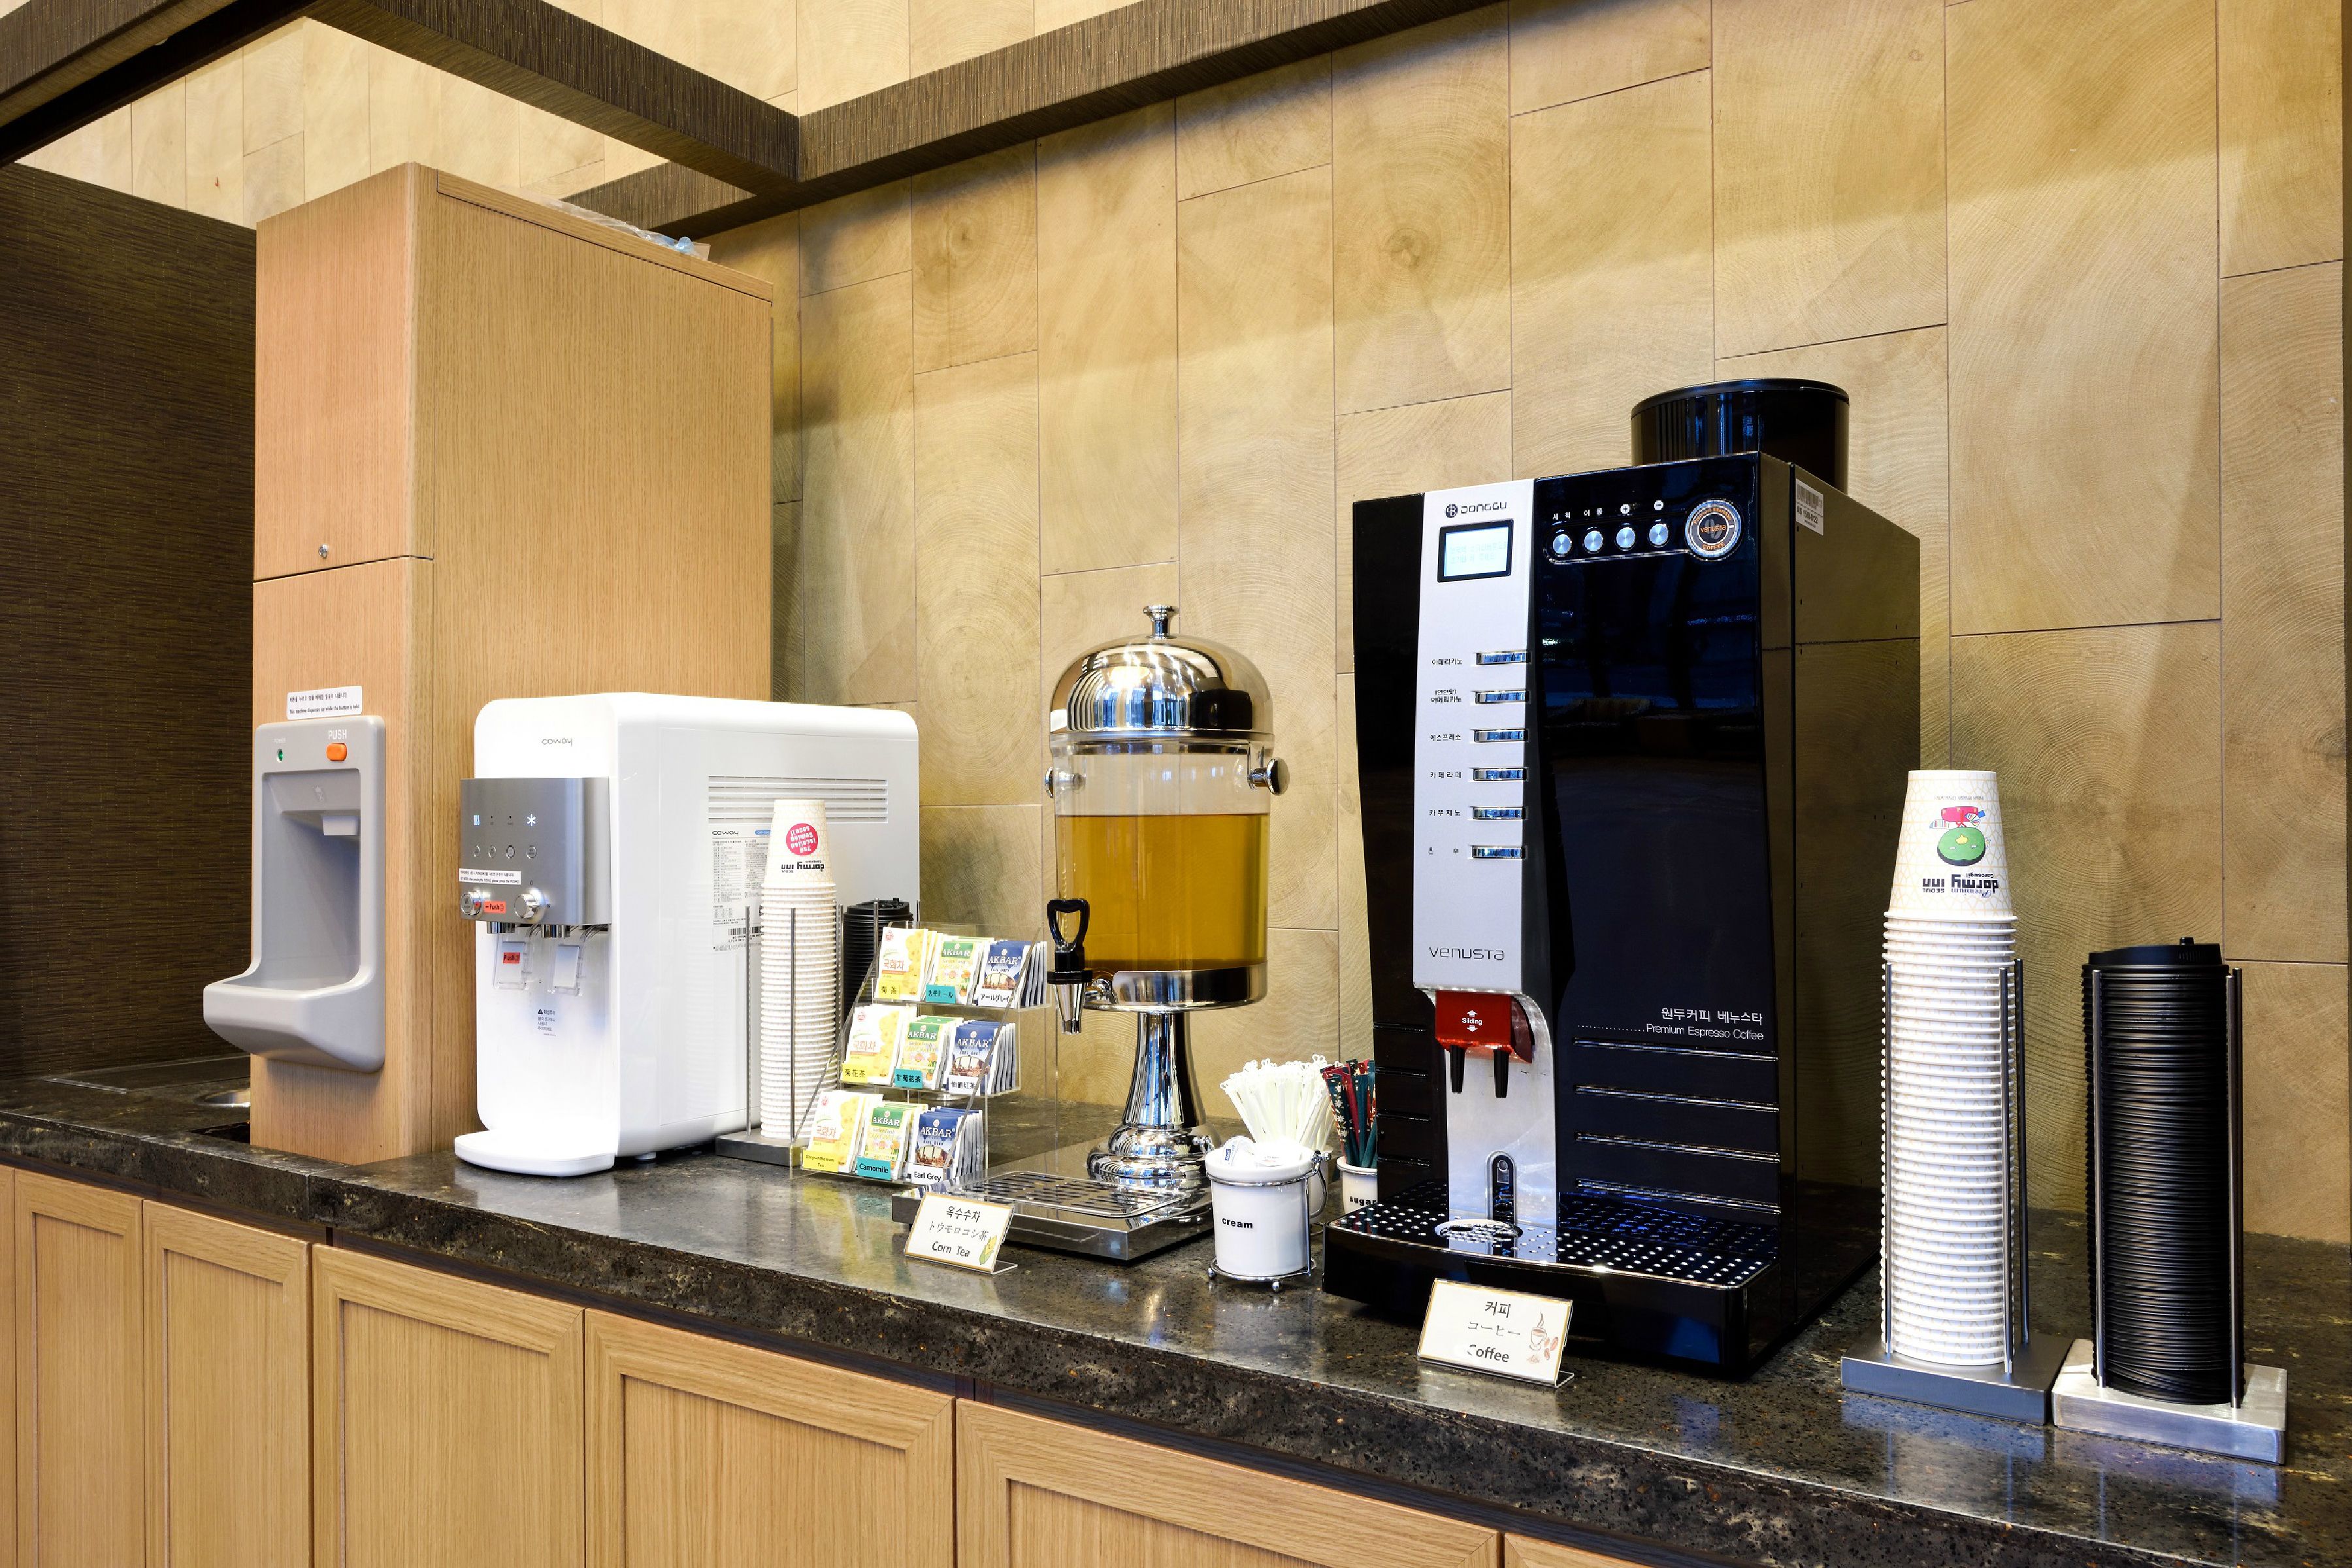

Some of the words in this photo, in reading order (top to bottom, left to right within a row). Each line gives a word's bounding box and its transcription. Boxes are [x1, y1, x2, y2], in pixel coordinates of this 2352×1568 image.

[328, 729, 348, 740] PUSH
[542, 738, 573, 747] coway
[797, 862, 825, 872] dormy
[1923, 878, 1945, 887] inn
[1951, 874, 1999, 892] dormy
[1952, 887, 1991, 898] Premium
[988, 956, 1018, 965] AKBAR
[928, 990, 953, 998] カモミール
[1462, 1017, 1482, 1026] Sliding
[1661, 1007, 1711, 1022] 원두커피
[1717, 1011, 1763, 1026] 베누스타
[908, 1031, 936, 1039] AKBAR
[1646, 1023, 1685, 1035] Premium
[1688, 1025, 1730, 1038] Espresso
[1733, 1029, 1764, 1040] Coffee
[956, 1038, 988, 1047] AKBAR
[872, 1117, 900, 1126] AKBAR
[920, 1126, 952, 1137] AKBAR
[859, 1163, 889, 1173] Camomile
[926, 1173, 941, 1182] Grey
[1349, 1196, 1377, 1206] sugar
[947, 1206, 981, 1223] 옥수수차
[1222, 1217, 1253, 1229] cream
[930, 1221, 989, 1241] トウモロコシ茶
[932, 1241, 951, 1254] Corn
[956, 1245, 970, 1257] Tea
[1485, 1301, 1511, 1318] 커피
[1467, 1322, 1520, 1336] コーヒー
